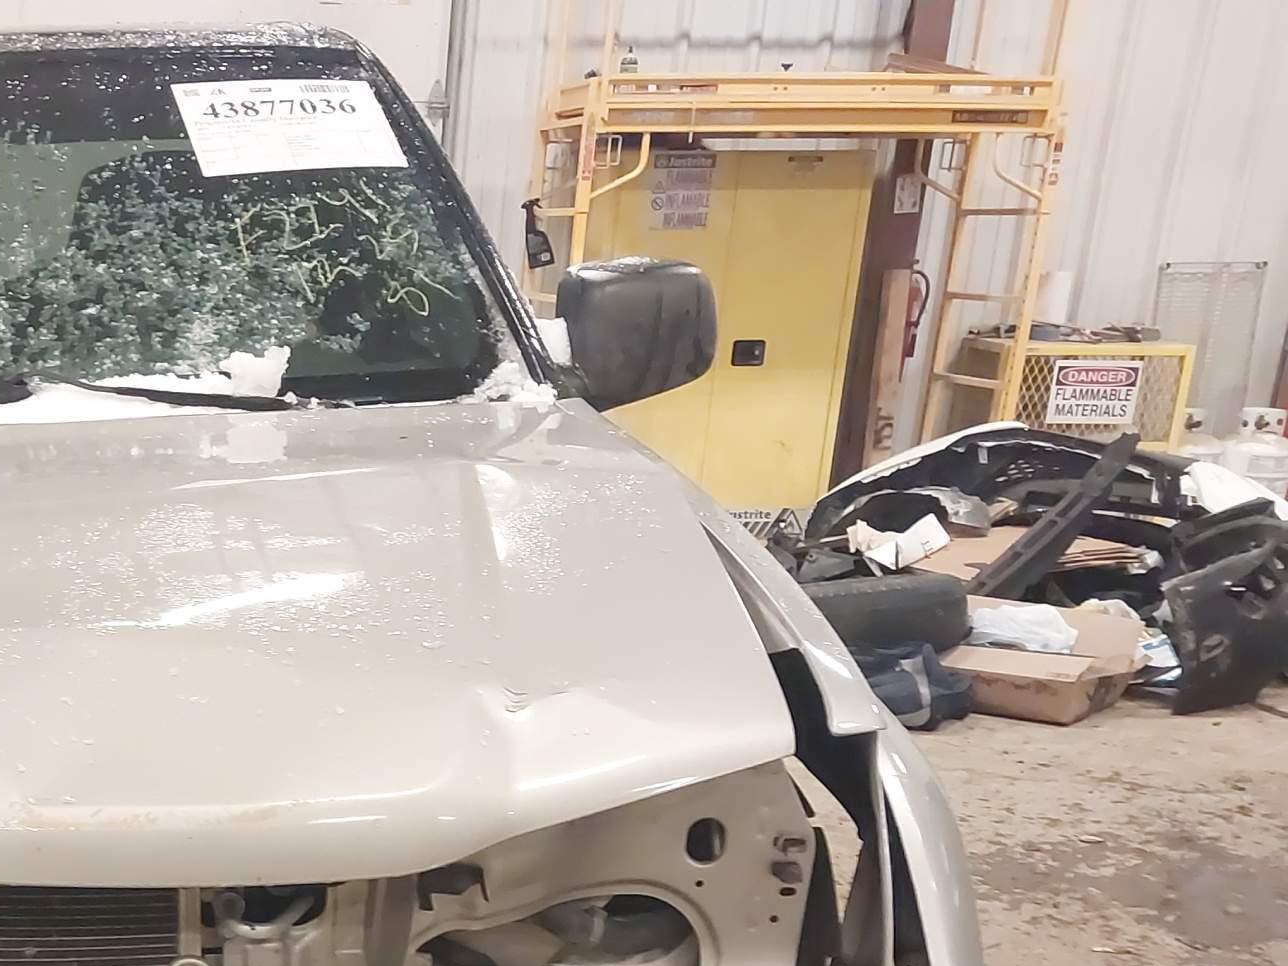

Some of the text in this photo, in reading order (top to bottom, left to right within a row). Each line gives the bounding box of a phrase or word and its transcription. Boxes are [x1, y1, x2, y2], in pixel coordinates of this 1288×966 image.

[203, 99, 357, 118] 43877036
[1068, 371, 1127, 382] DANGER
[1054, 388, 1132, 401] FLAMMABLE
[1054, 404, 1127, 417] MATERIALS
